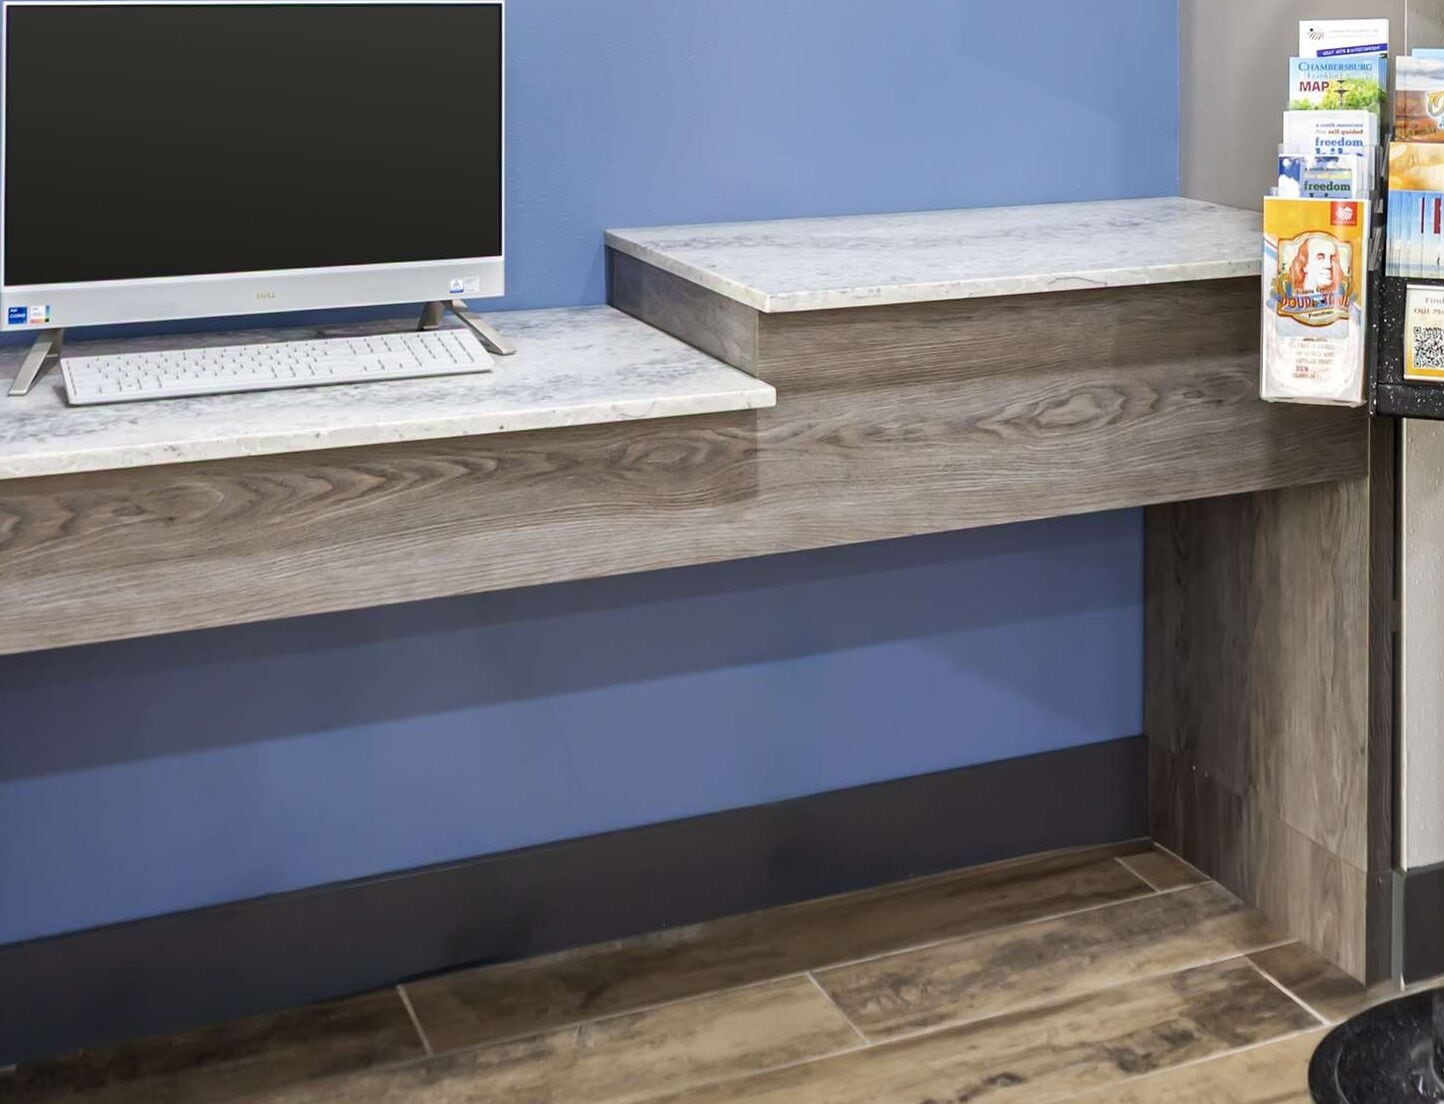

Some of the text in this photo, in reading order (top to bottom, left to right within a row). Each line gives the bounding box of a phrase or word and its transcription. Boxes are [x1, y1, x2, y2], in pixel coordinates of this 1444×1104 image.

[1299, 81, 1330, 92] MAP
[1315, 137, 1363, 147] freedom
[1304, 181, 1350, 191] freedom
